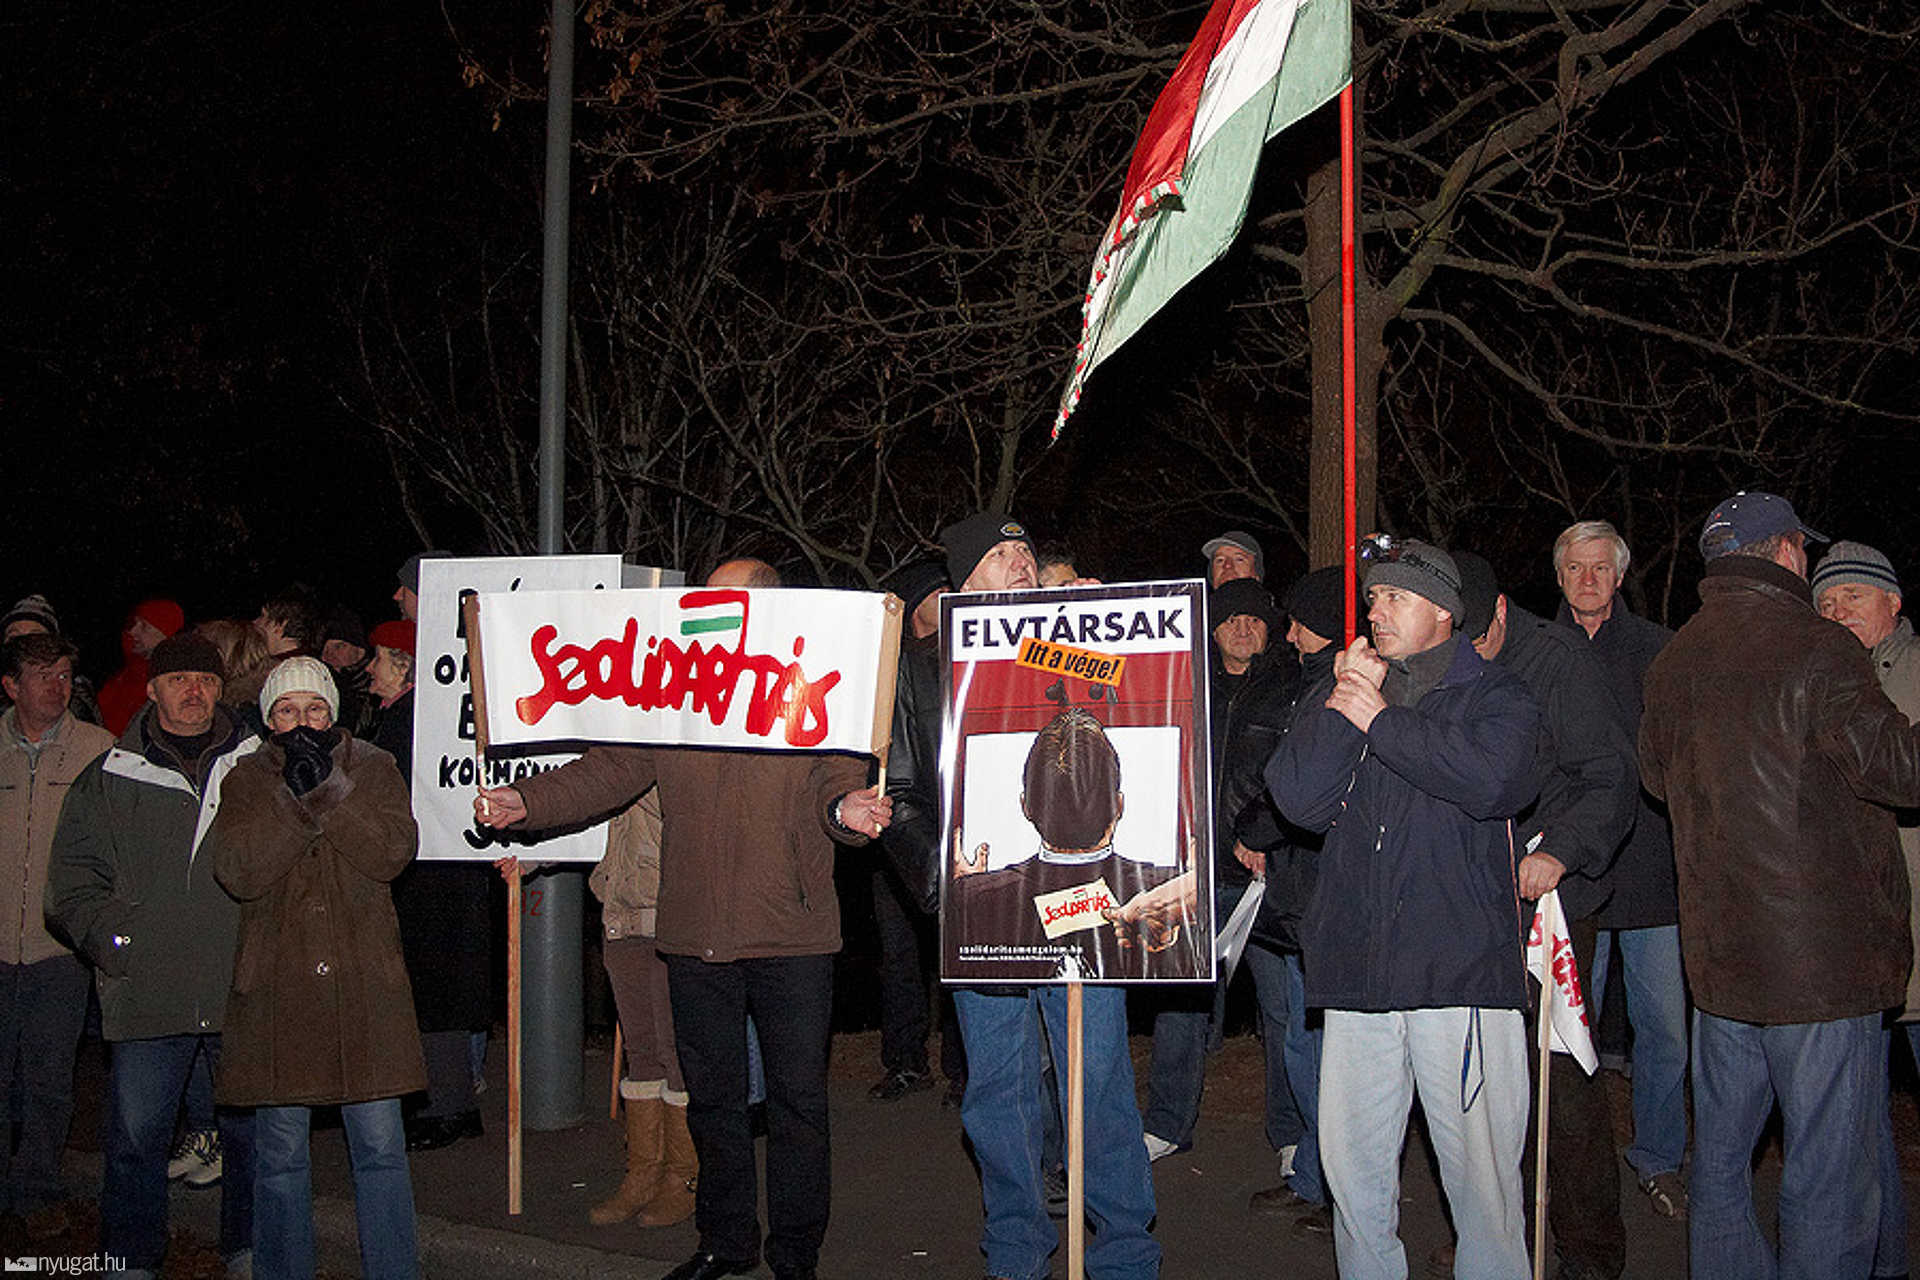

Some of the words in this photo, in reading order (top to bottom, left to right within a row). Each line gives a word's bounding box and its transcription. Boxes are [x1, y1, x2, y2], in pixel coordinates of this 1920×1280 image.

[961, 605, 1185, 648] ELVTÁRSAK
[1024, 641, 1049, 666] Itt
[1048, 650, 1063, 669] a
[1064, 652, 1120, 680] vége!
